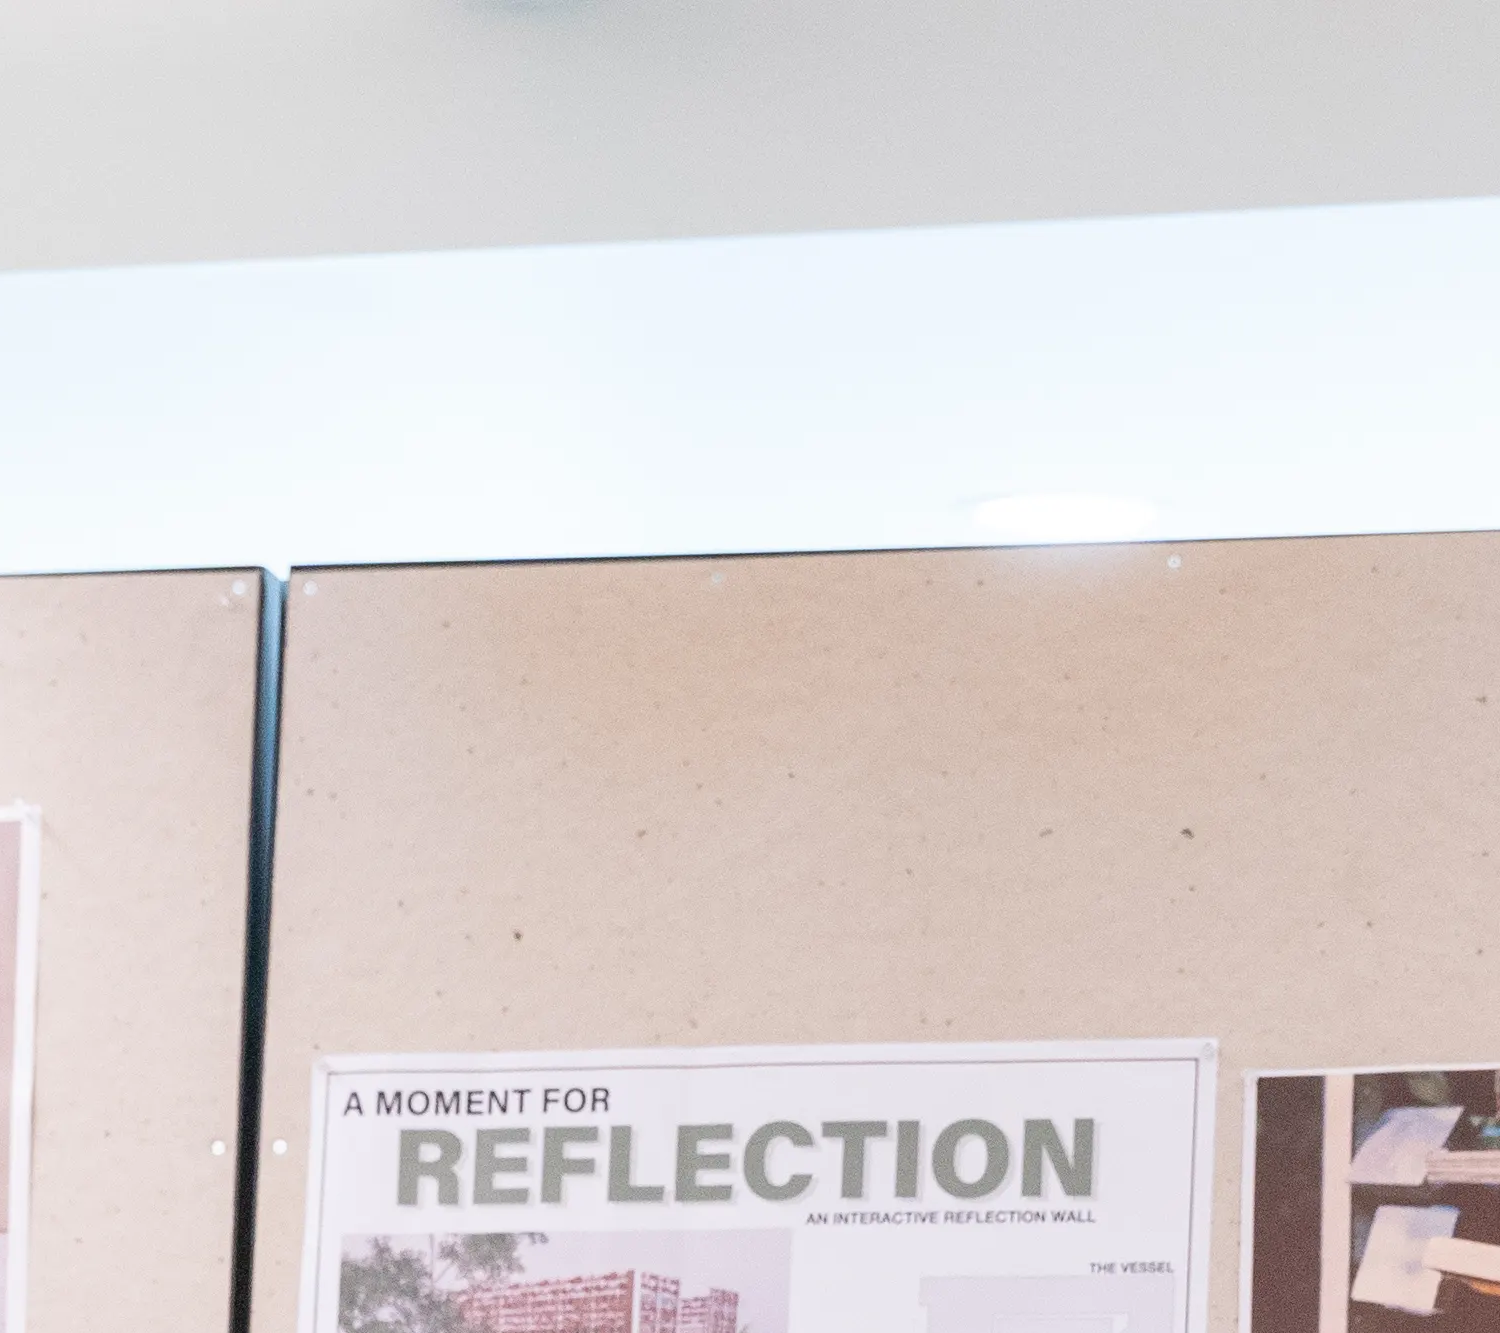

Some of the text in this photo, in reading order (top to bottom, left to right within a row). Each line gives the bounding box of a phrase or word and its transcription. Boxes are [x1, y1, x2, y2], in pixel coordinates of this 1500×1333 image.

[343, 1087, 612, 1117] A MOMENT FOR
[396, 1118, 1099, 1207] REFLECTION
[806, 1210, 1096, 1225] AN INTERACTIVE REFLECTION WALL
[1089, 1262, 1174, 1274] THE VESSEL
